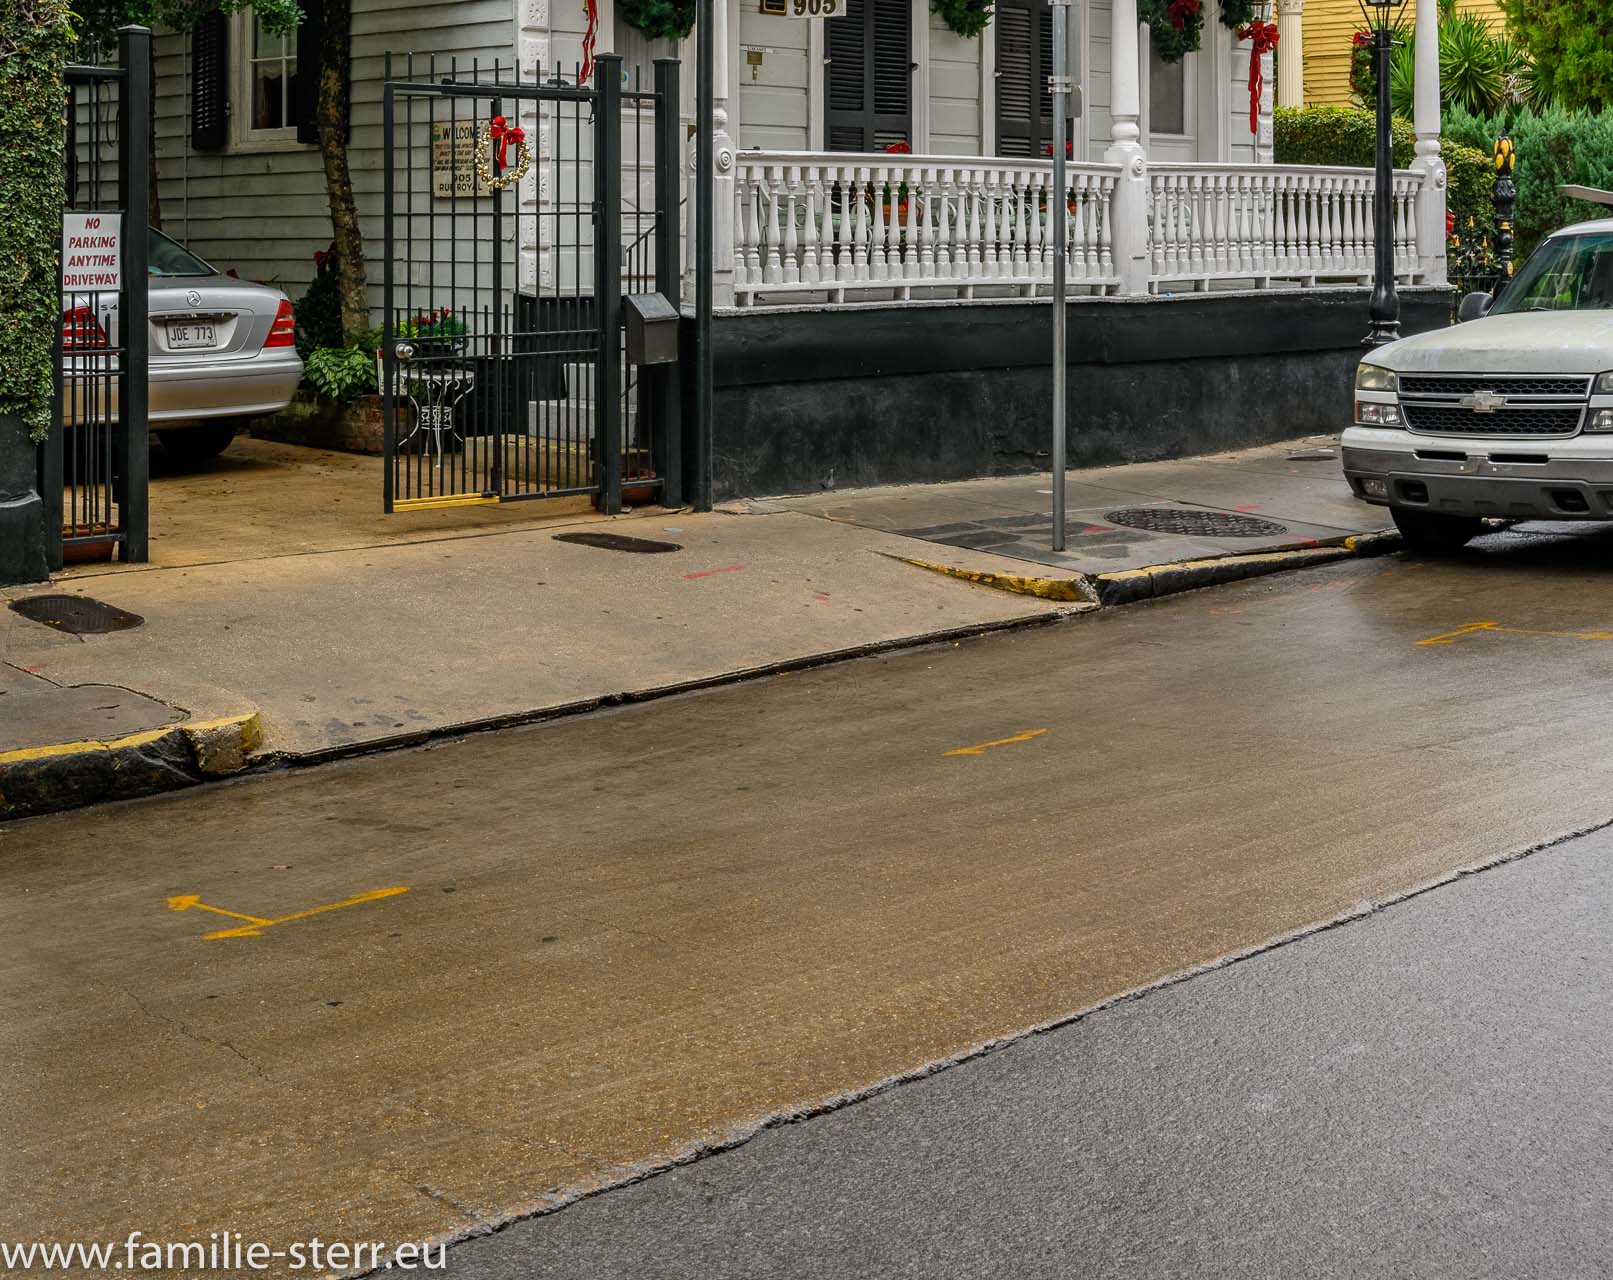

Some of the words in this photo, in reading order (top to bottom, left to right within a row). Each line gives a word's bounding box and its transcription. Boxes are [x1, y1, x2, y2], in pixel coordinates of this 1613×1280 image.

[443, 127, 481, 139] WLCOME
[457, 183, 483, 191] ROYL
[85, 218, 100, 229] NO
[69, 236, 116, 248] PARKING
[68, 255, 116, 267] ANYTIME
[63, 273, 118, 286] DRIVEWAY
[171, 327, 189, 341] JDE
[194, 327, 213, 340] 773
